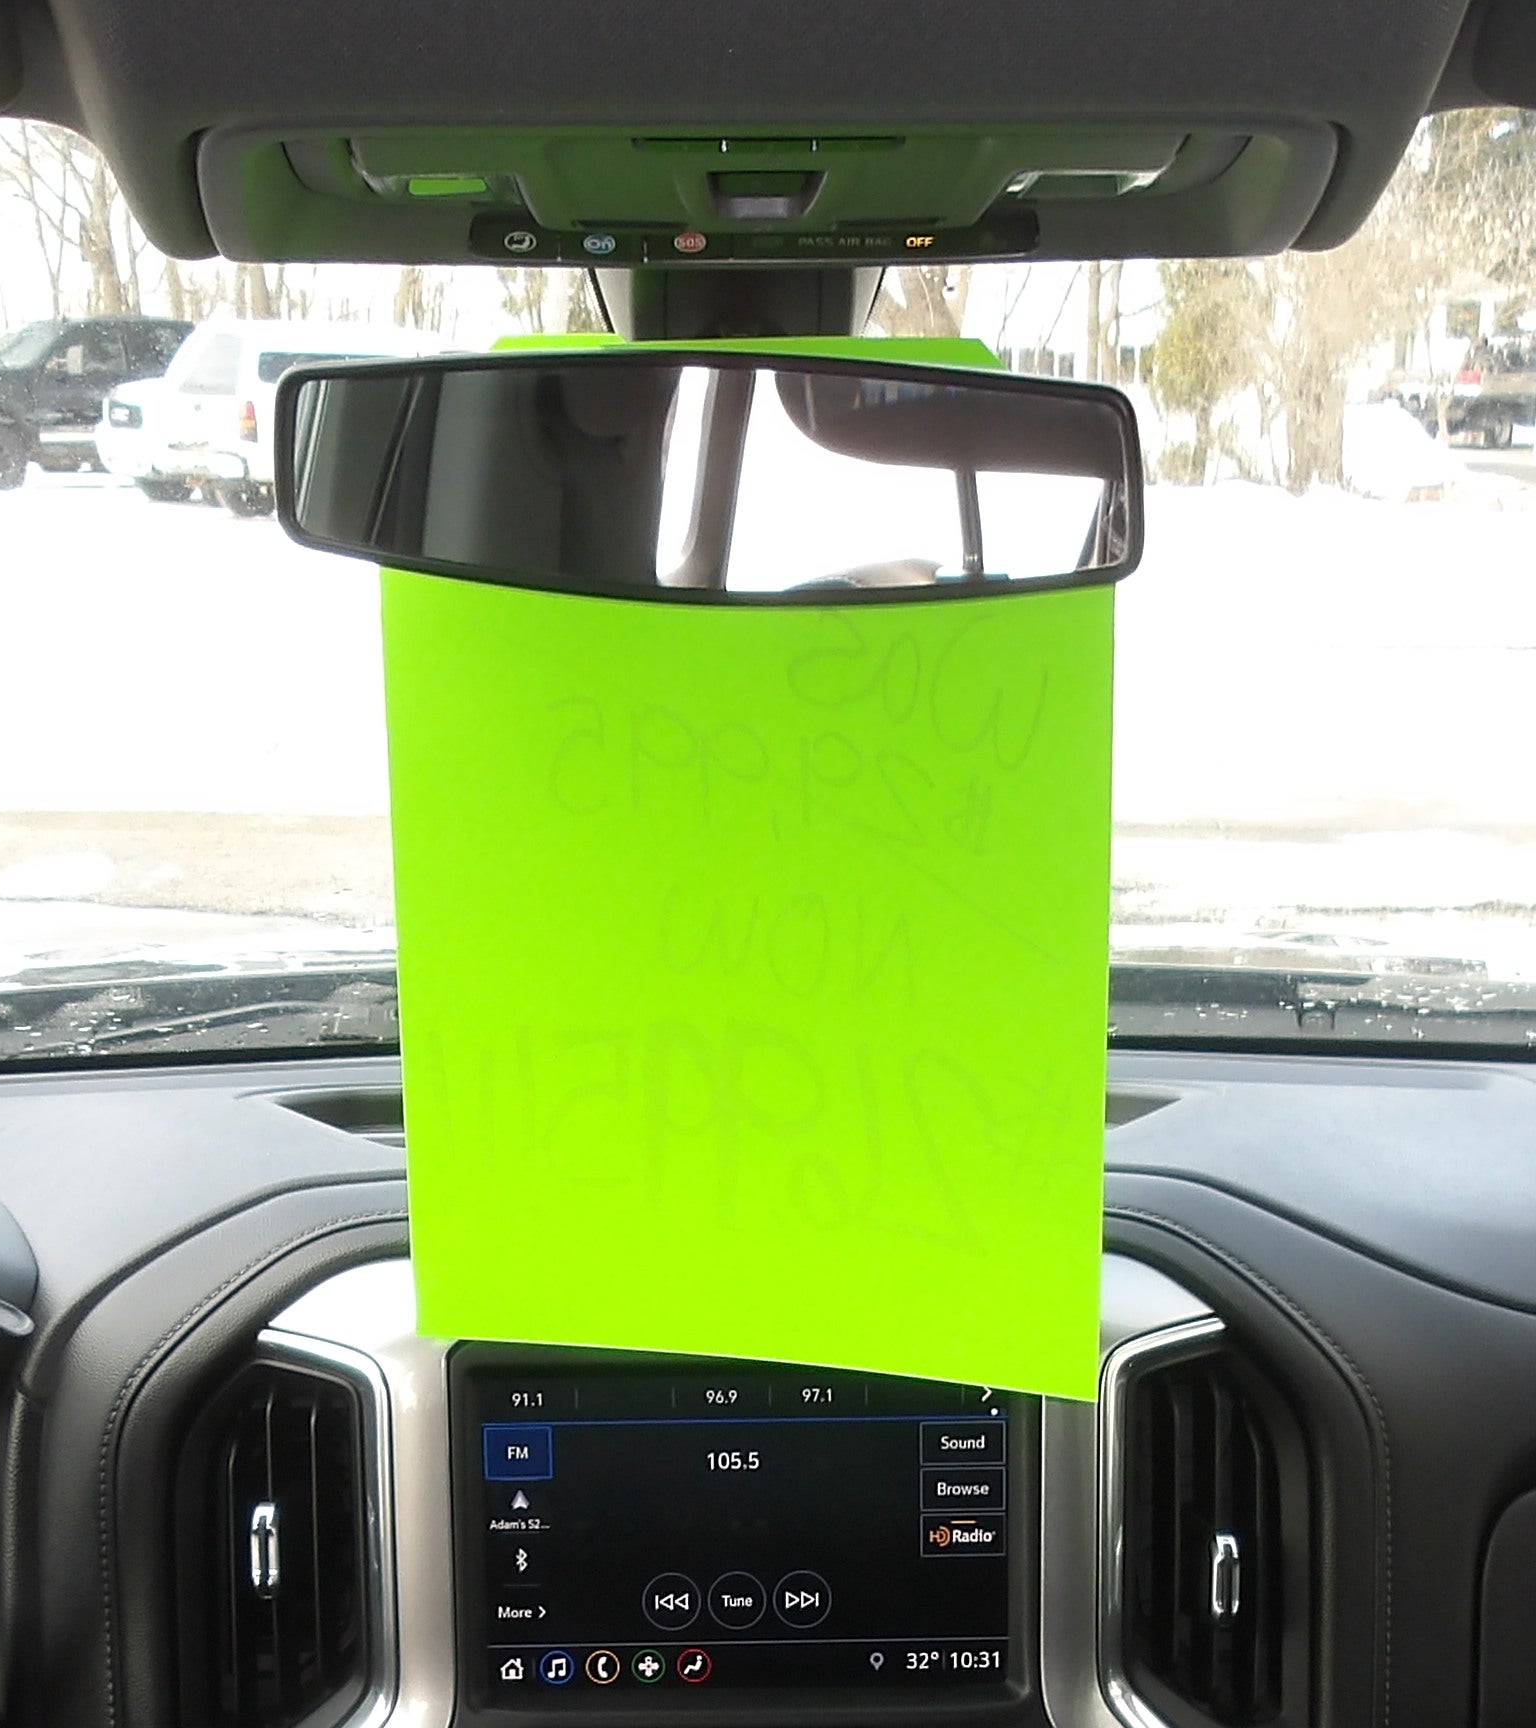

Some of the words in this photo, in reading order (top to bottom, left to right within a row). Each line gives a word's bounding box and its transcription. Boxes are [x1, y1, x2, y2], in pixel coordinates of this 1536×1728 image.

[905, 235, 935, 248] OFF
[512, 1393, 543, 1407] 91.1
[706, 1390, 738, 1404] 96.9
[802, 1388, 833, 1403] 97.1
[940, 1435, 985, 1450] Sound
[507, 1447, 529, 1460] FM
[707, 1452, 760, 1470] 105.5
[937, 1482, 990, 1496] Browse
[722, 1595, 753, 1608] Tune
[498, 1606, 532, 1619] More
[906, 1651, 940, 1670] 32°
[950, 1651, 1001, 1669] 10:31
